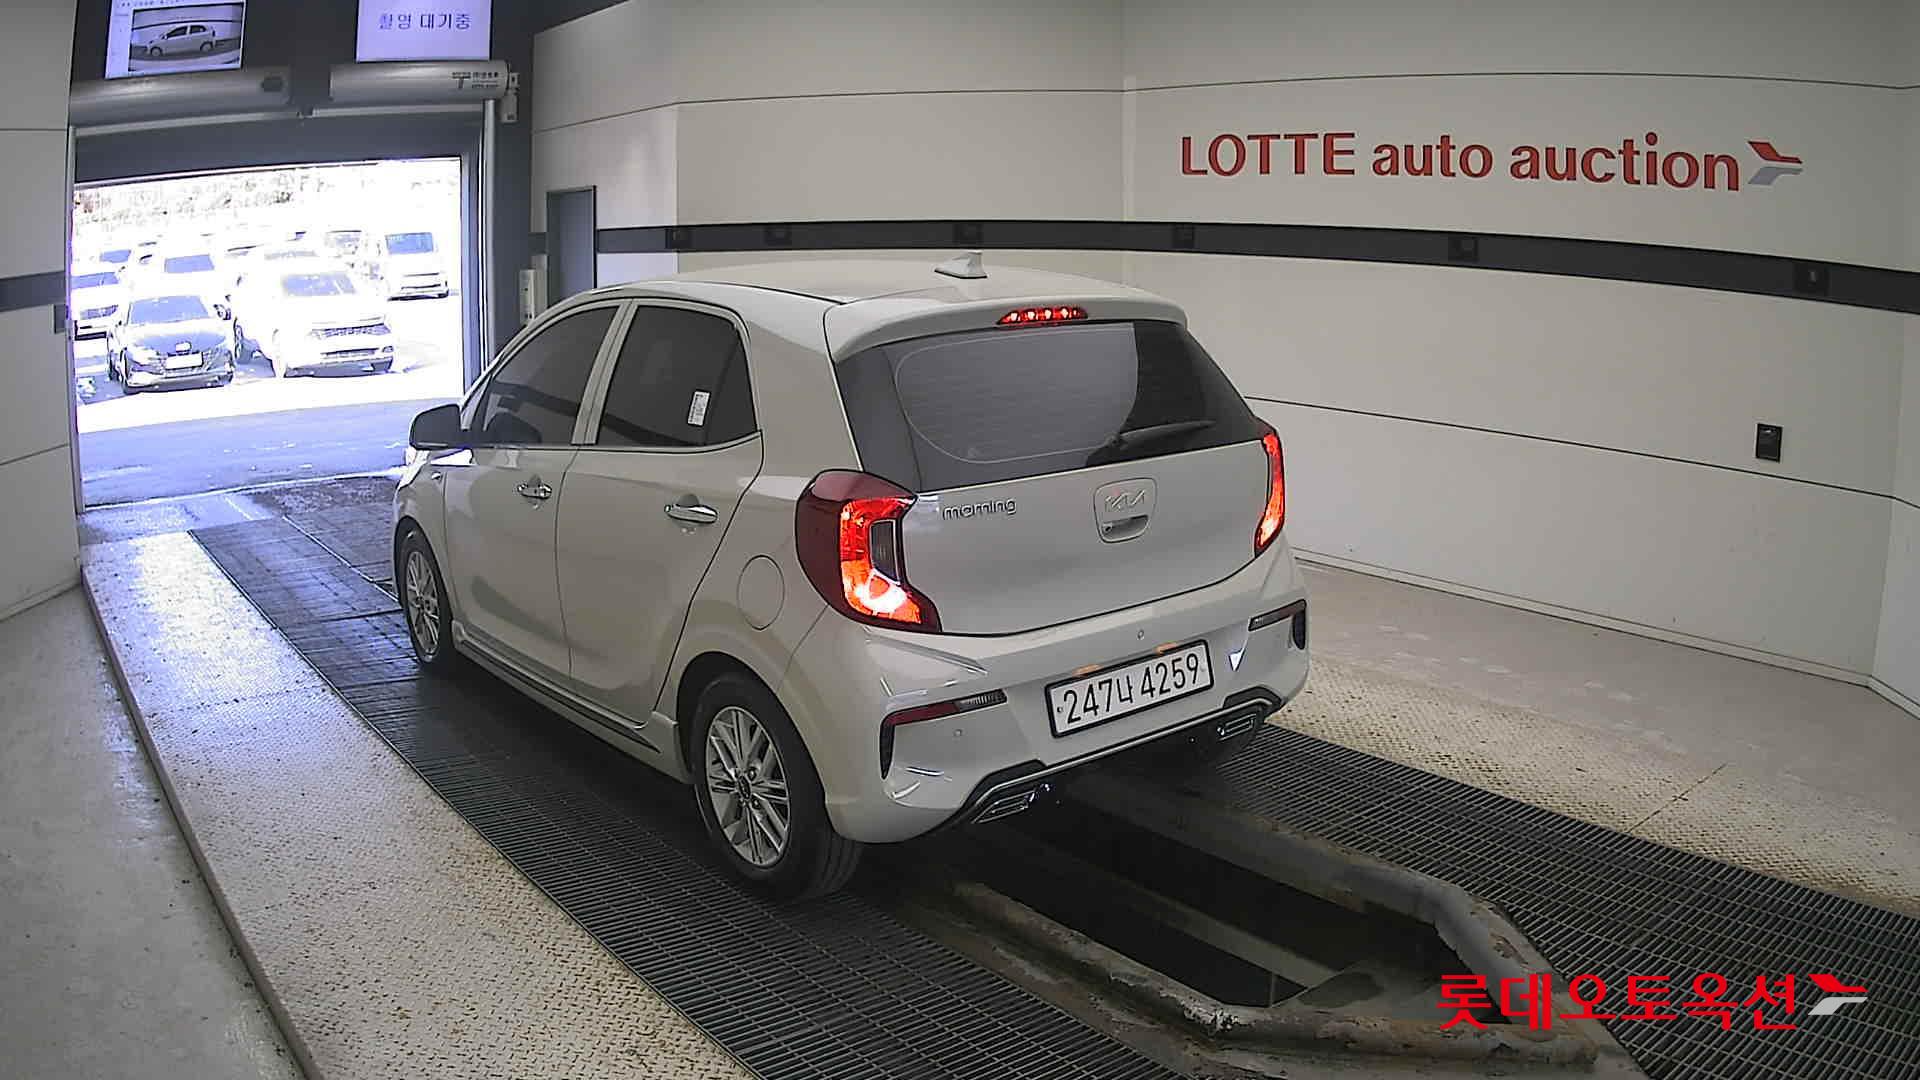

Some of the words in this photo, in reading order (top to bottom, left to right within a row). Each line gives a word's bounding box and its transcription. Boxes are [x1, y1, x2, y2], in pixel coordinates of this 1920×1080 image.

[420, 13, 473, 30] 대기중
[1182, 131, 1356, 177] LOTTE
[1373, 136, 1493, 178] auto
[1511, 132, 1740, 191] auction
[942, 498, 1017, 521] morning
[1063, 675, 1134, 725] 247나
[1140, 652, 1200, 699] 4259
